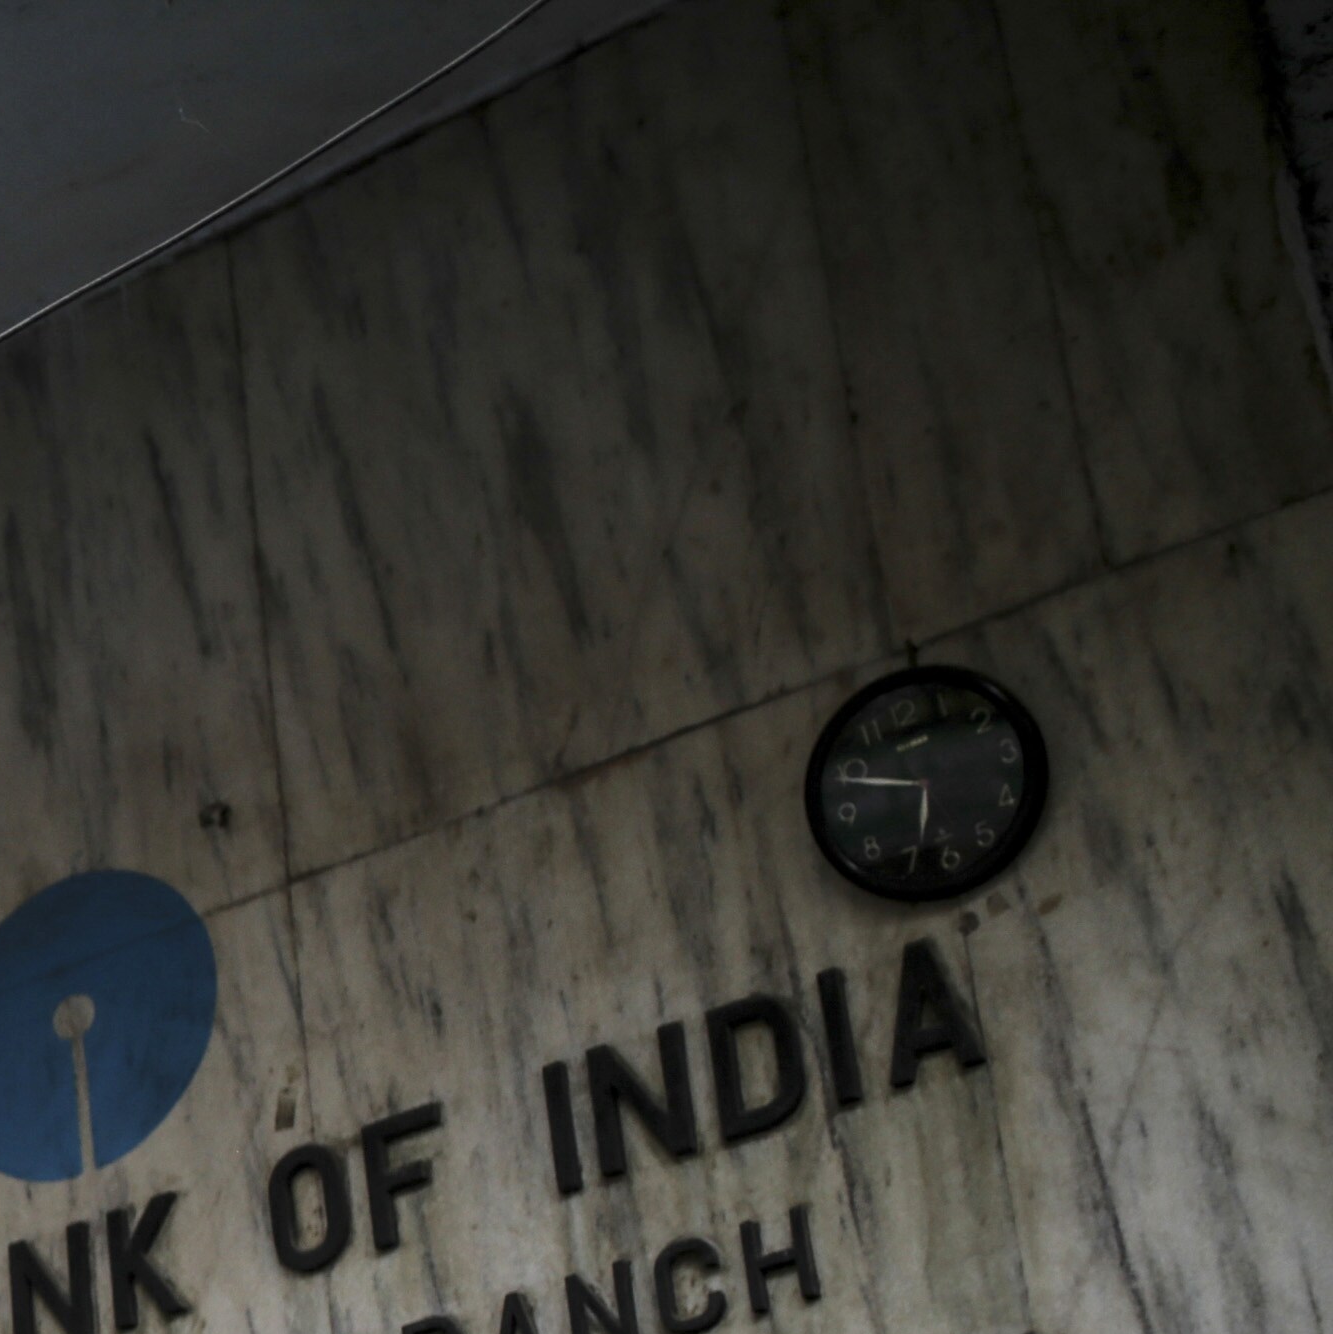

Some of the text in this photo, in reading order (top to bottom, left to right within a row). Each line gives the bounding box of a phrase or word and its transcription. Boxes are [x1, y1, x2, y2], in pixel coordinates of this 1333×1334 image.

[890, 698, 916, 728] 12
[969, 706, 995, 736] 2
[859, 719, 883, 747] 11
[999, 738, 1018, 765] 3
[998, 783, 1016, 808] 4
[837, 801, 858, 826] 9
[974, 819, 996, 849] 5
[863, 835, 882, 861] 8
[941, 847, 961, 870] 6
[267, 1103, 443, 1275] OF
[542, 938, 987, 1198] INDIA
